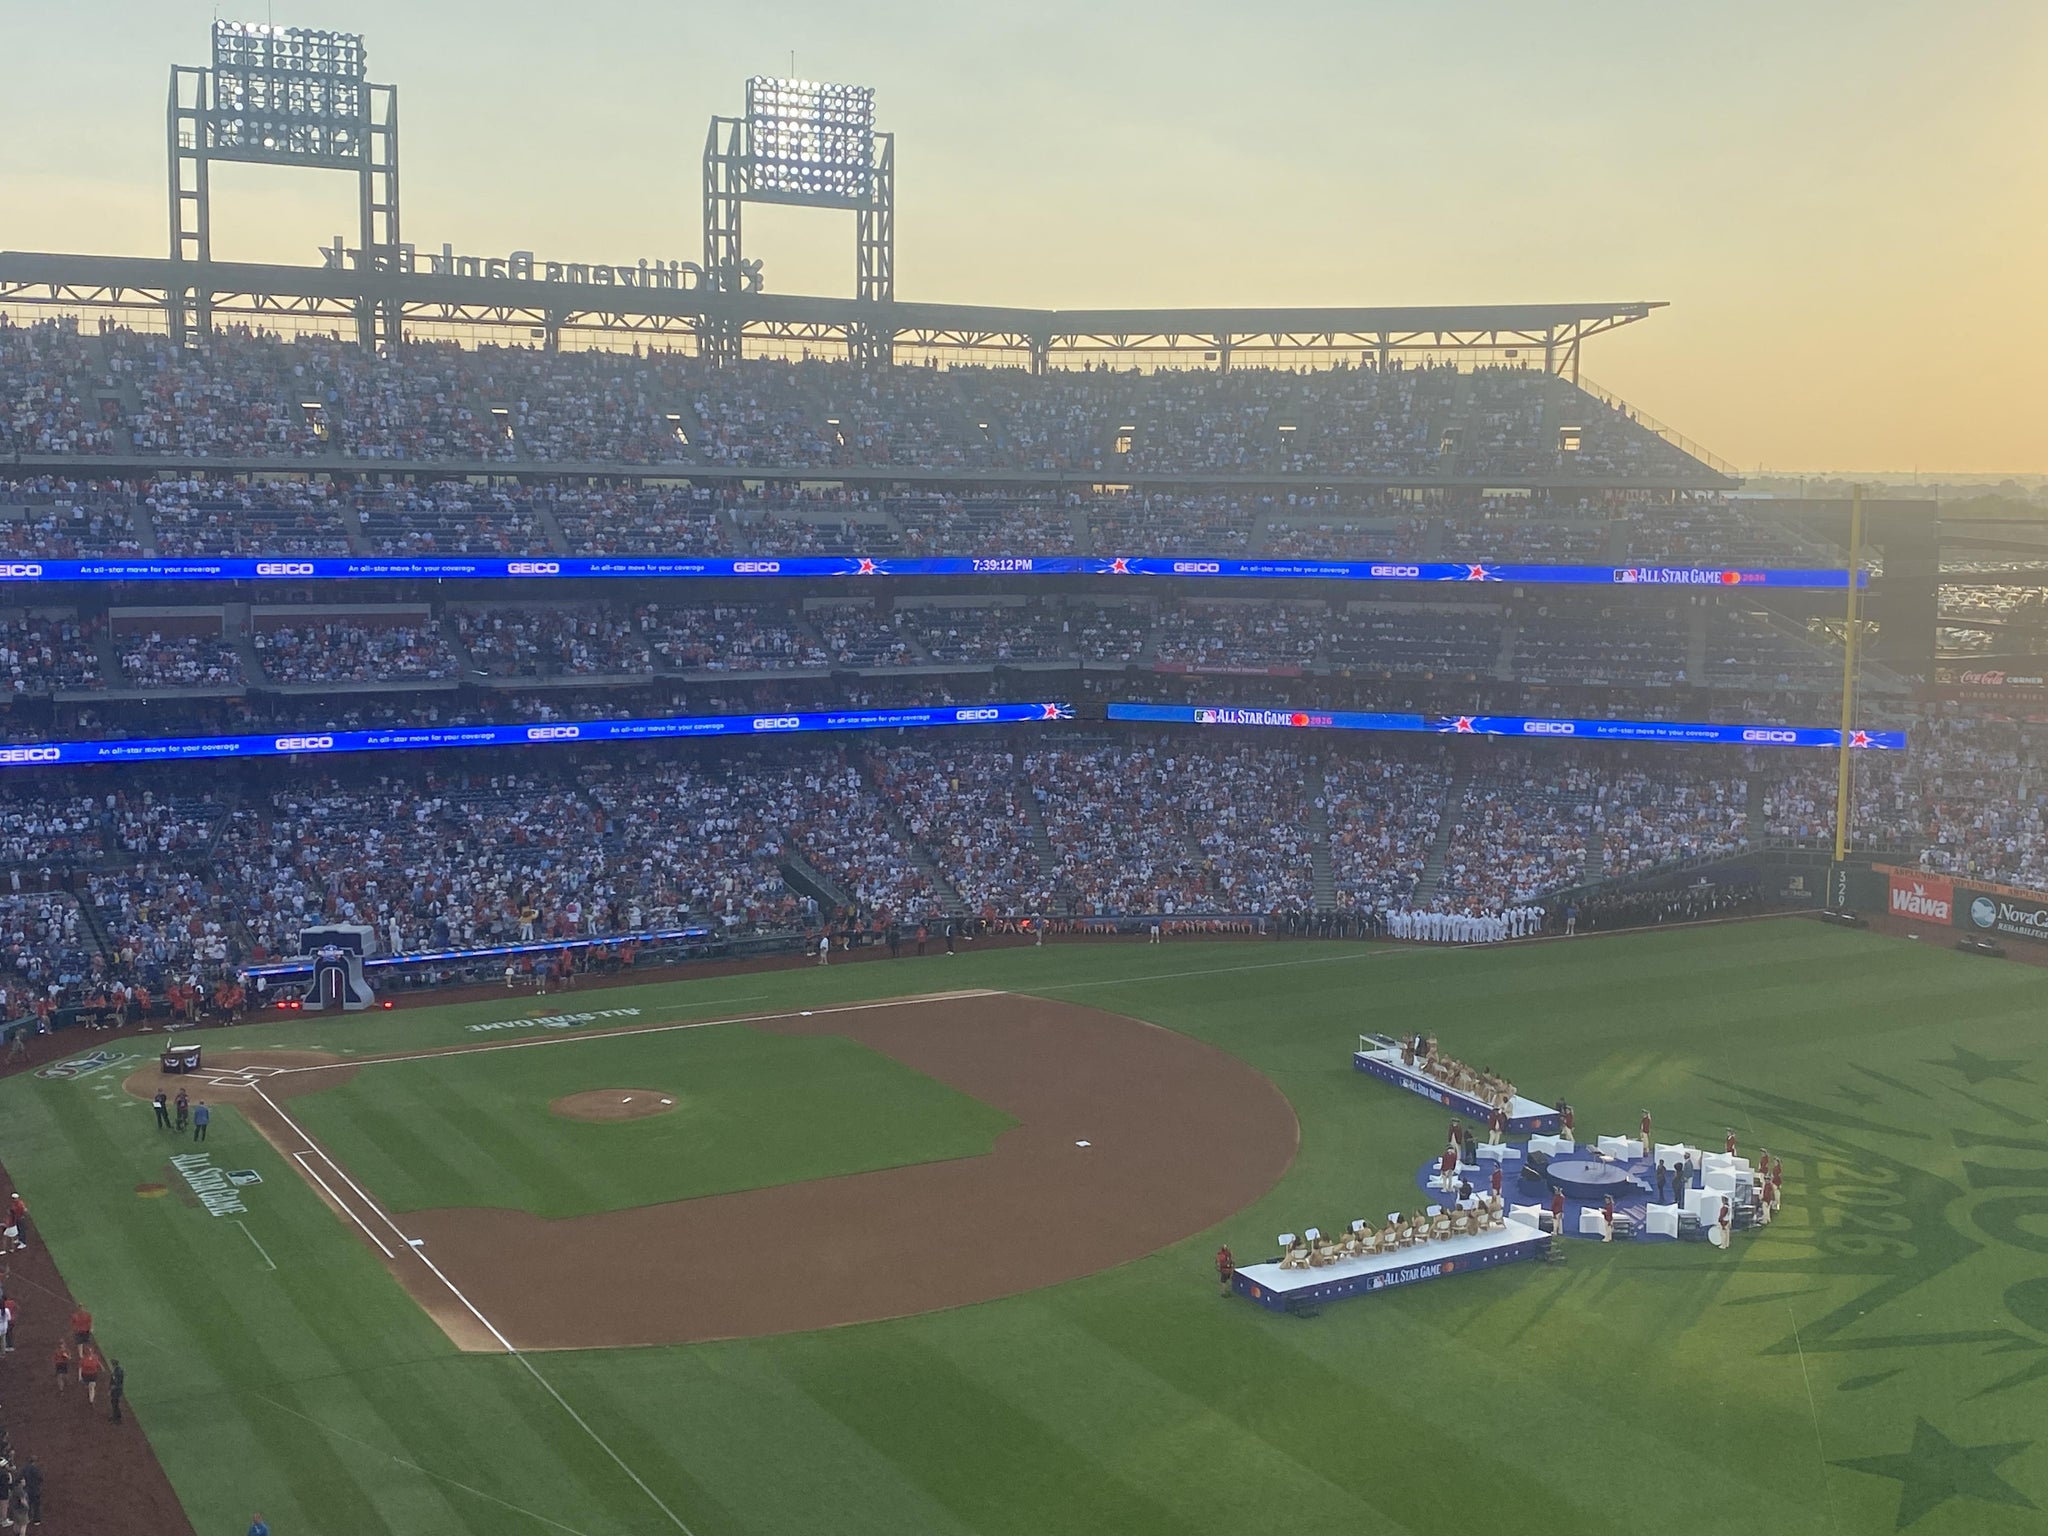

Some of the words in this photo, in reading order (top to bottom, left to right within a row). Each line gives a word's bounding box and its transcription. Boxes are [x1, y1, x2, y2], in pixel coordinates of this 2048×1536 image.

[257, 563, 314, 575] GEICO
[508, 563, 560, 574] GEICO
[733, 562, 780, 573] GEICO
[972, 559, 1014, 571] 7:39:12
[1015, 559, 1033, 571] PM
[1173, 562, 1220, 574] GEICO
[1370, 565, 1420, 577] GEICO
[1638, 568, 1660, 582] ALL
[1661, 568, 1690, 583] STAR
[1690, 569, 1721, 584] GAME
[957, 709, 999, 721] GEICO
[1216, 708, 1237, 724] ALL
[1238, 709, 1263, 725] STAR
[1263, 710, 1292, 726] GAME
[754, 717, 800, 729] GEICO
[1523, 722, 1575, 734] GEICO
[527, 727, 580, 739] GEICO
[1742, 730, 1797, 743] GEICO
[275, 737, 334, 750] GEICO
[0, 748, 60, 762] GEICO
[1838, 871, 1847, 907] 329
[1892, 888, 1949, 919] Wawa
[597, 1007, 642, 1017] ALL
[464, 1019, 534, 1032] GAME
[534, 1013, 597, 1025] STAR
[169, 1152, 211, 1172] ALL
[182, 1167, 228, 1193] STAR
[198, 1189, 249, 1217] GAME
[1817, 1161, 1920, 1259] 2026
[1383, 1272, 1400, 1286] ALL
[1400, 1268, 1420, 1283] STAR
[1420, 1263, 1442, 1279] GAME
